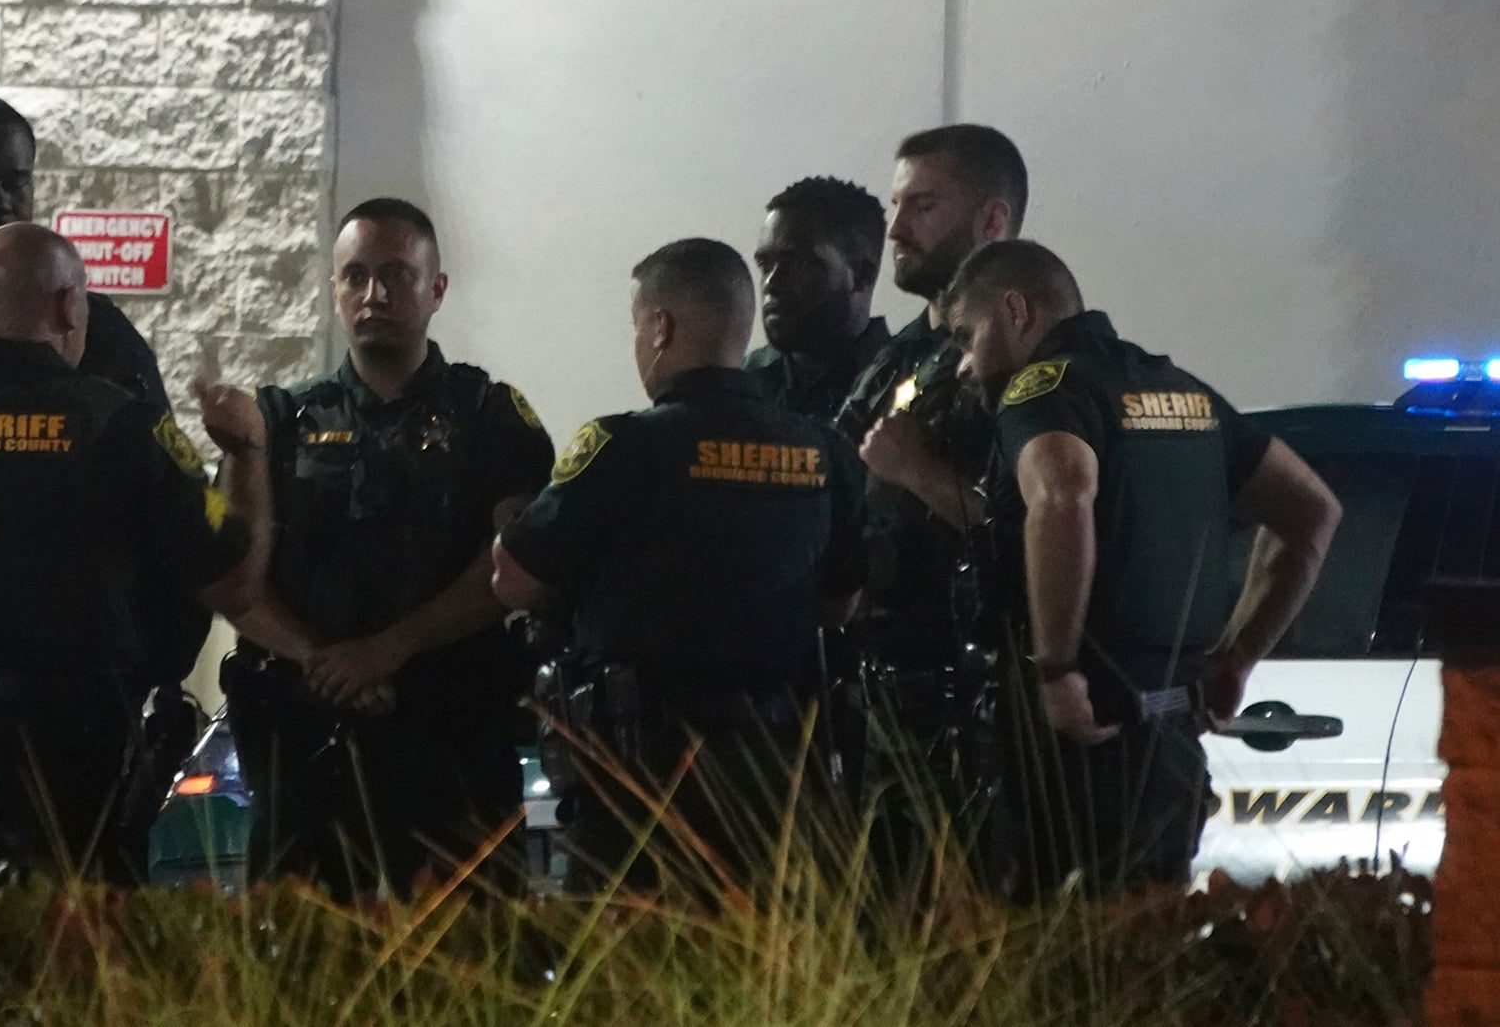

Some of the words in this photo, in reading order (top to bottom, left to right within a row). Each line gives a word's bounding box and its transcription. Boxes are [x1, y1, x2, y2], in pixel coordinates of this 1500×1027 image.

[60, 215, 166, 238] EMERGENCY
[71, 240, 155, 263] HUT-OFF
[84, 265, 146, 286] WITCH
[4, 438, 73, 453] COUNTY
[697, 440, 821, 472] SHERIFF
